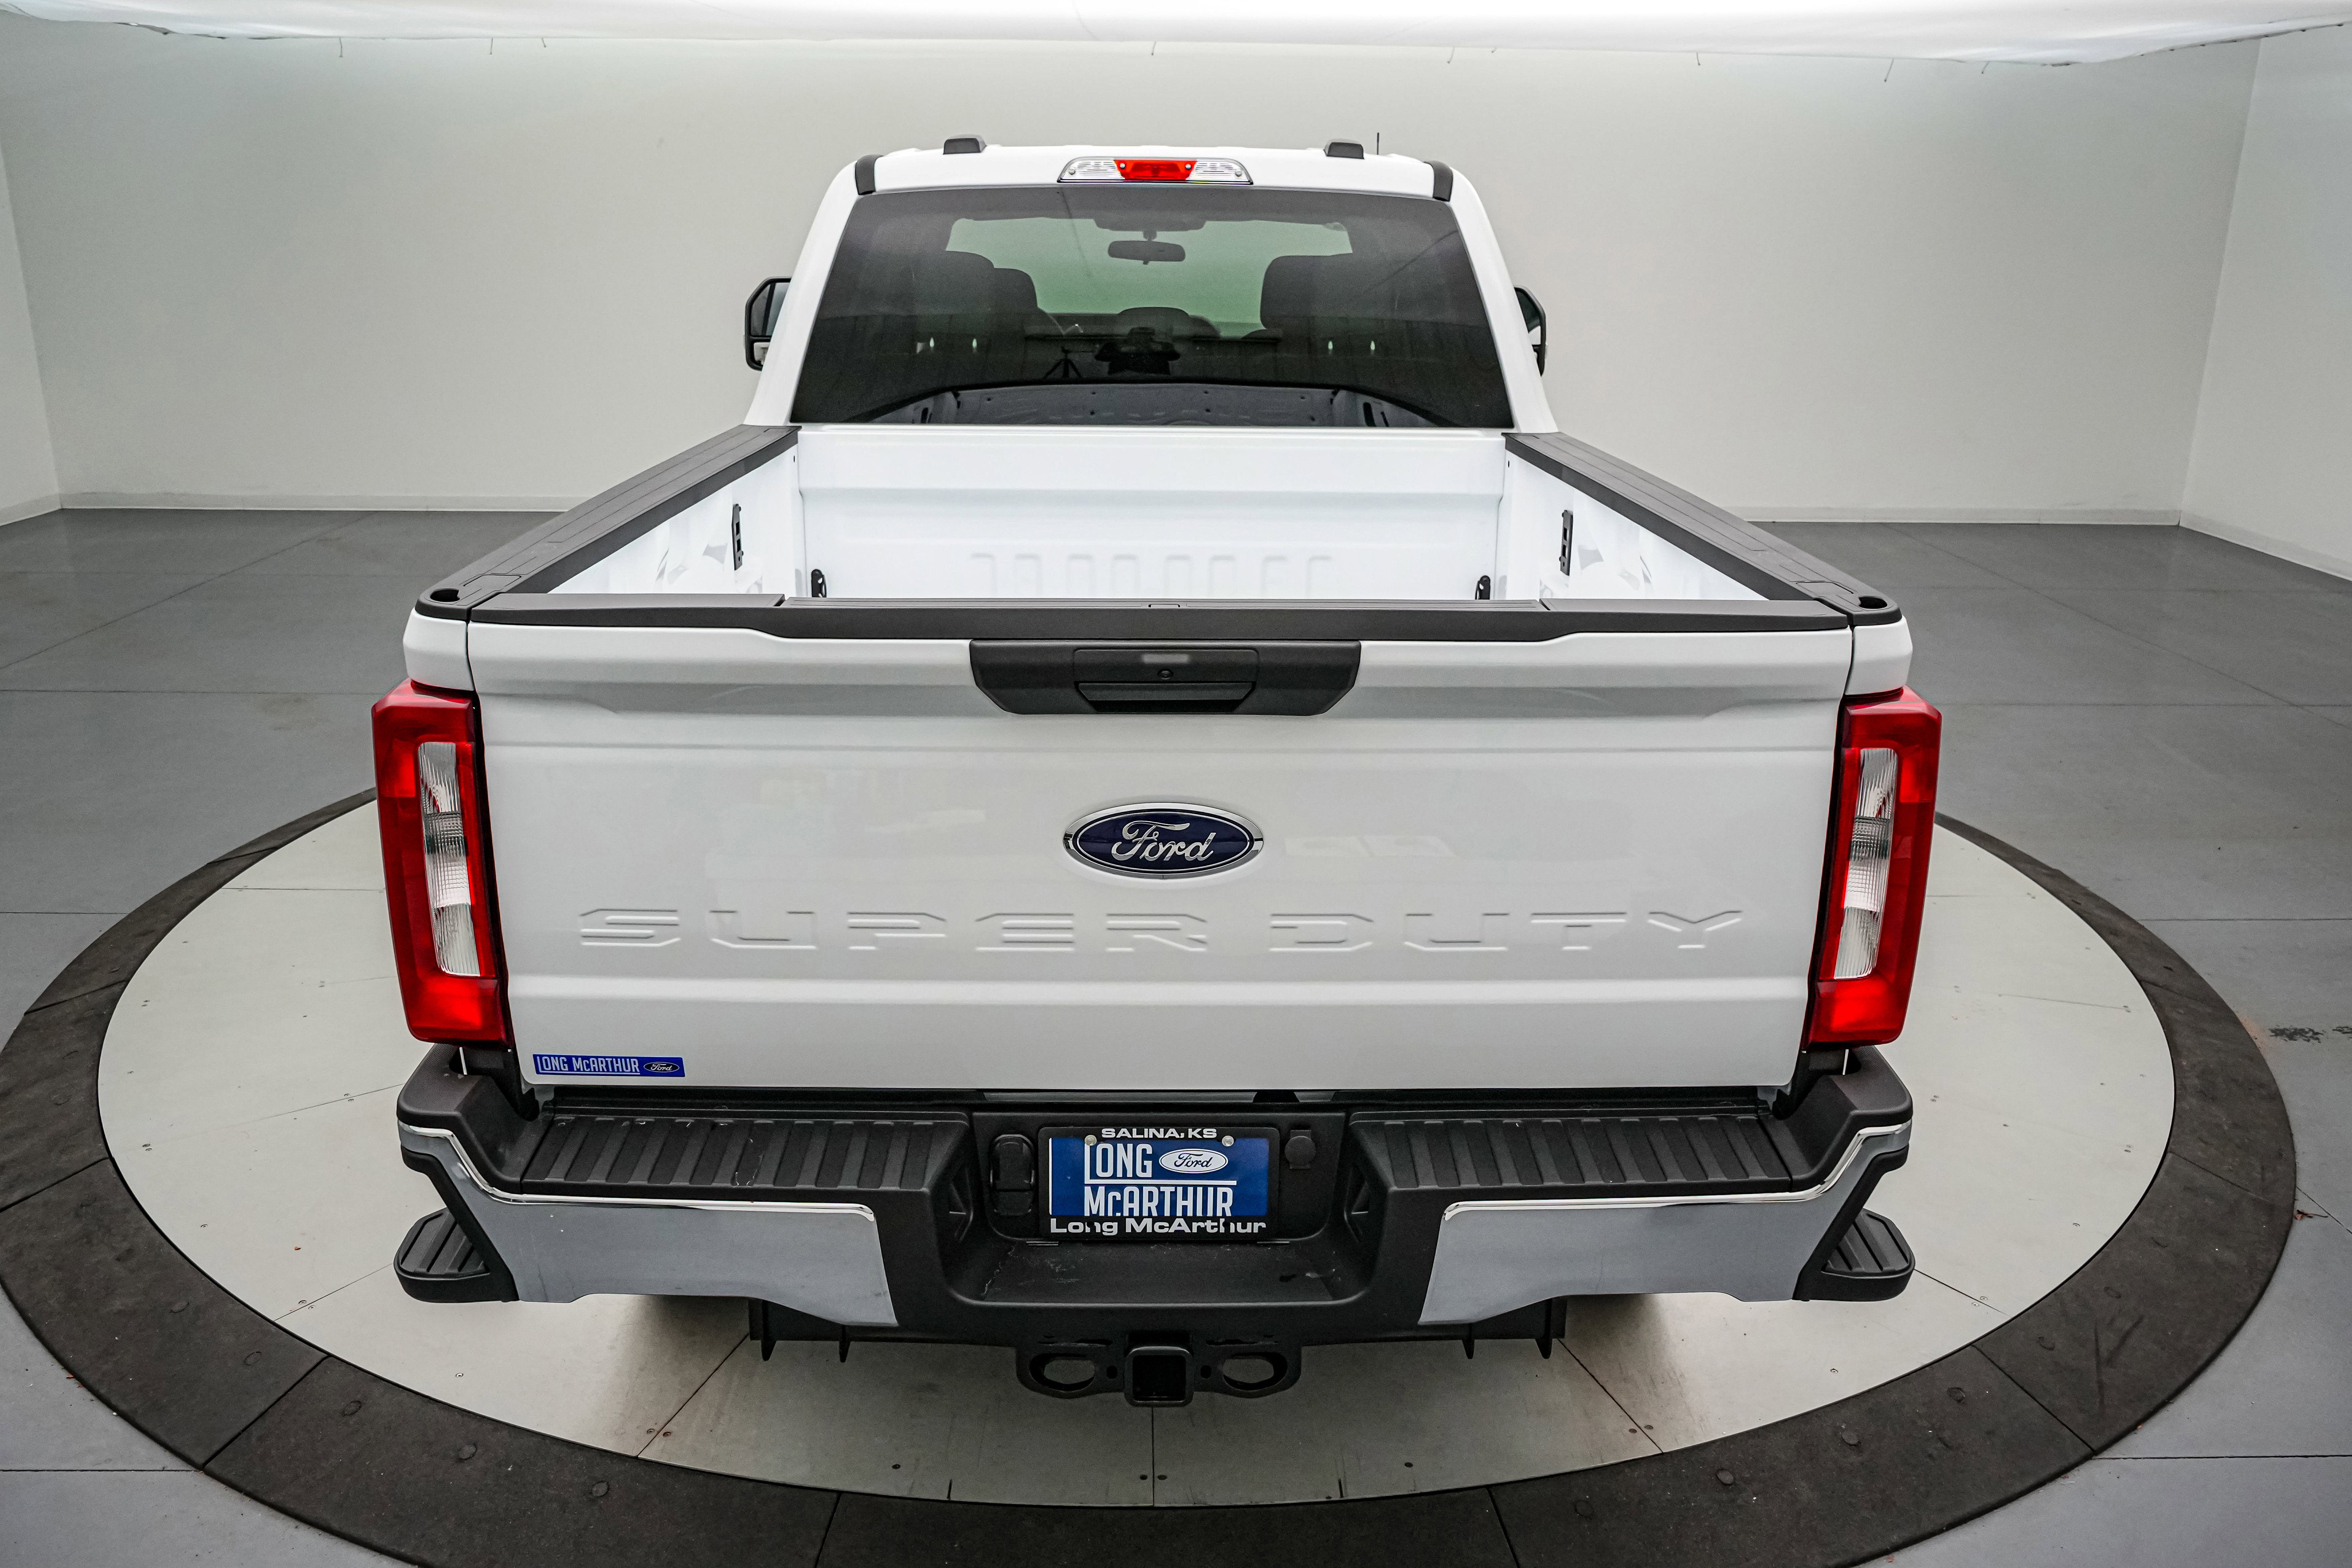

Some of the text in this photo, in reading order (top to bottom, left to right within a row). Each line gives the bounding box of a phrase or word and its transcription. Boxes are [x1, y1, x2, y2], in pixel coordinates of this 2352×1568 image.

[1111, 820, 1216, 861] Ford
[579, 908, 1743, 951] SUPER DUTY
[537, 1056, 640, 1073] LONG McARTHUR
[650, 1063, 672, 1071] Ford
[1188, 1128, 1217, 1138] KS
[1084, 1142, 1153, 1185] LONG
[1174, 1152, 1213, 1168] Ford
[1050, 1218, 1266, 1236] Long McArthur
